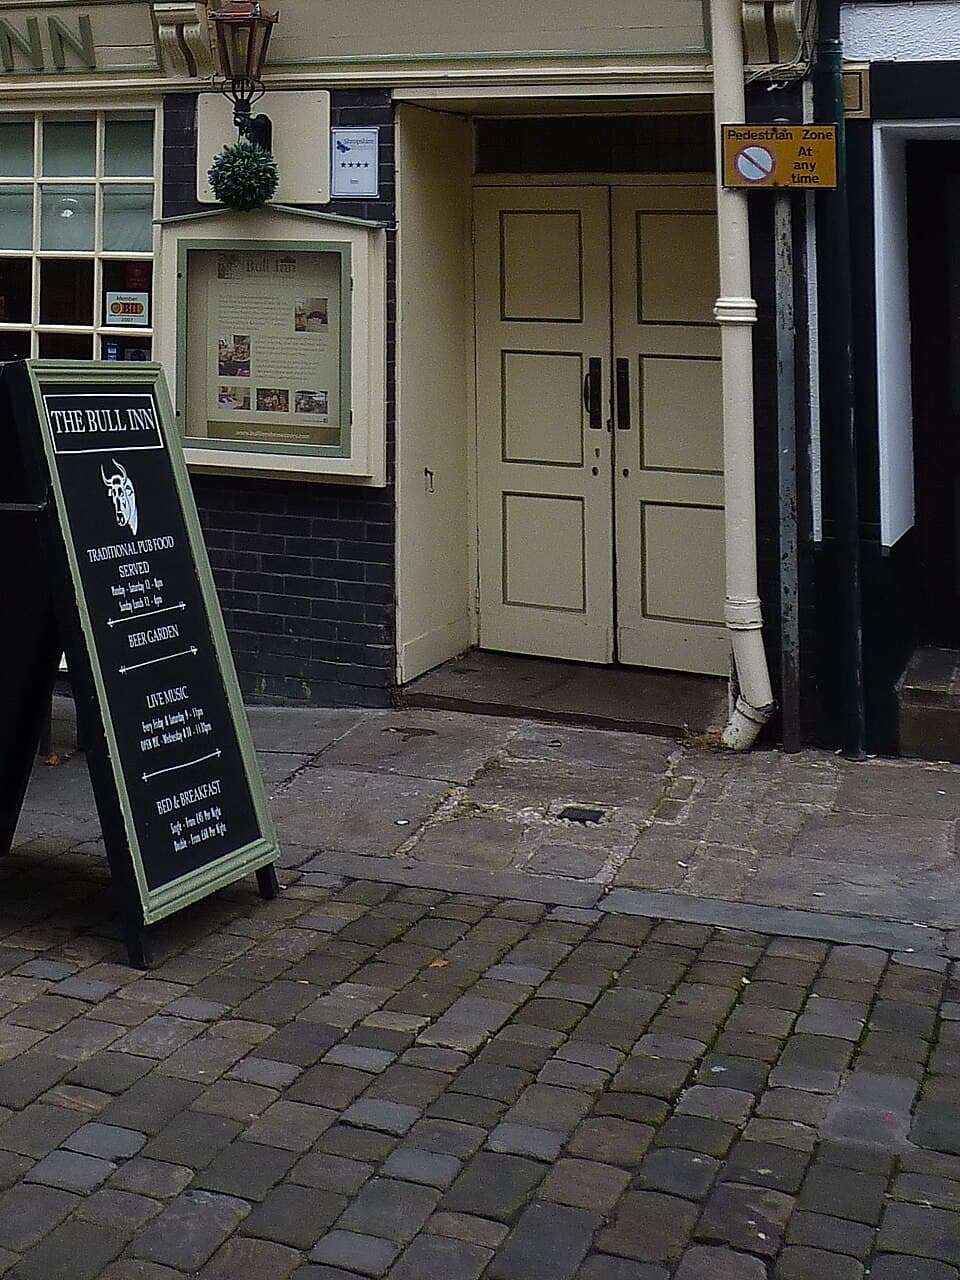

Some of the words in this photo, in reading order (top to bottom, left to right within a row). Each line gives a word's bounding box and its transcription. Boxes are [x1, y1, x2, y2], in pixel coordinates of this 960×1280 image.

[727, 129, 793, 141] Pedestrian
[802, 129, 833, 141] Zone
[798, 146, 813, 157] At
[793, 161, 817, 172] any
[792, 173, 819, 184] time
[50, 410, 85, 433] THE
[85, 409, 126, 431] BULL
[126, 408, 155, 430] INN
[87, 542, 138, 563] TRADITIONAL
[137, 539, 154, 554] PUB
[153, 535, 175, 551] FOOD
[119, 561, 150, 578] SERVED
[128, 630, 148, 648] BEER
[147, 624, 180, 643] GARDEN
[146, 692, 165, 709] LIVE
[163, 685, 189, 704] MUSIC
[156, 798, 173, 815] BED
[173, 795, 180, 809] &
[179, 779, 221, 807] BREAKFAST
